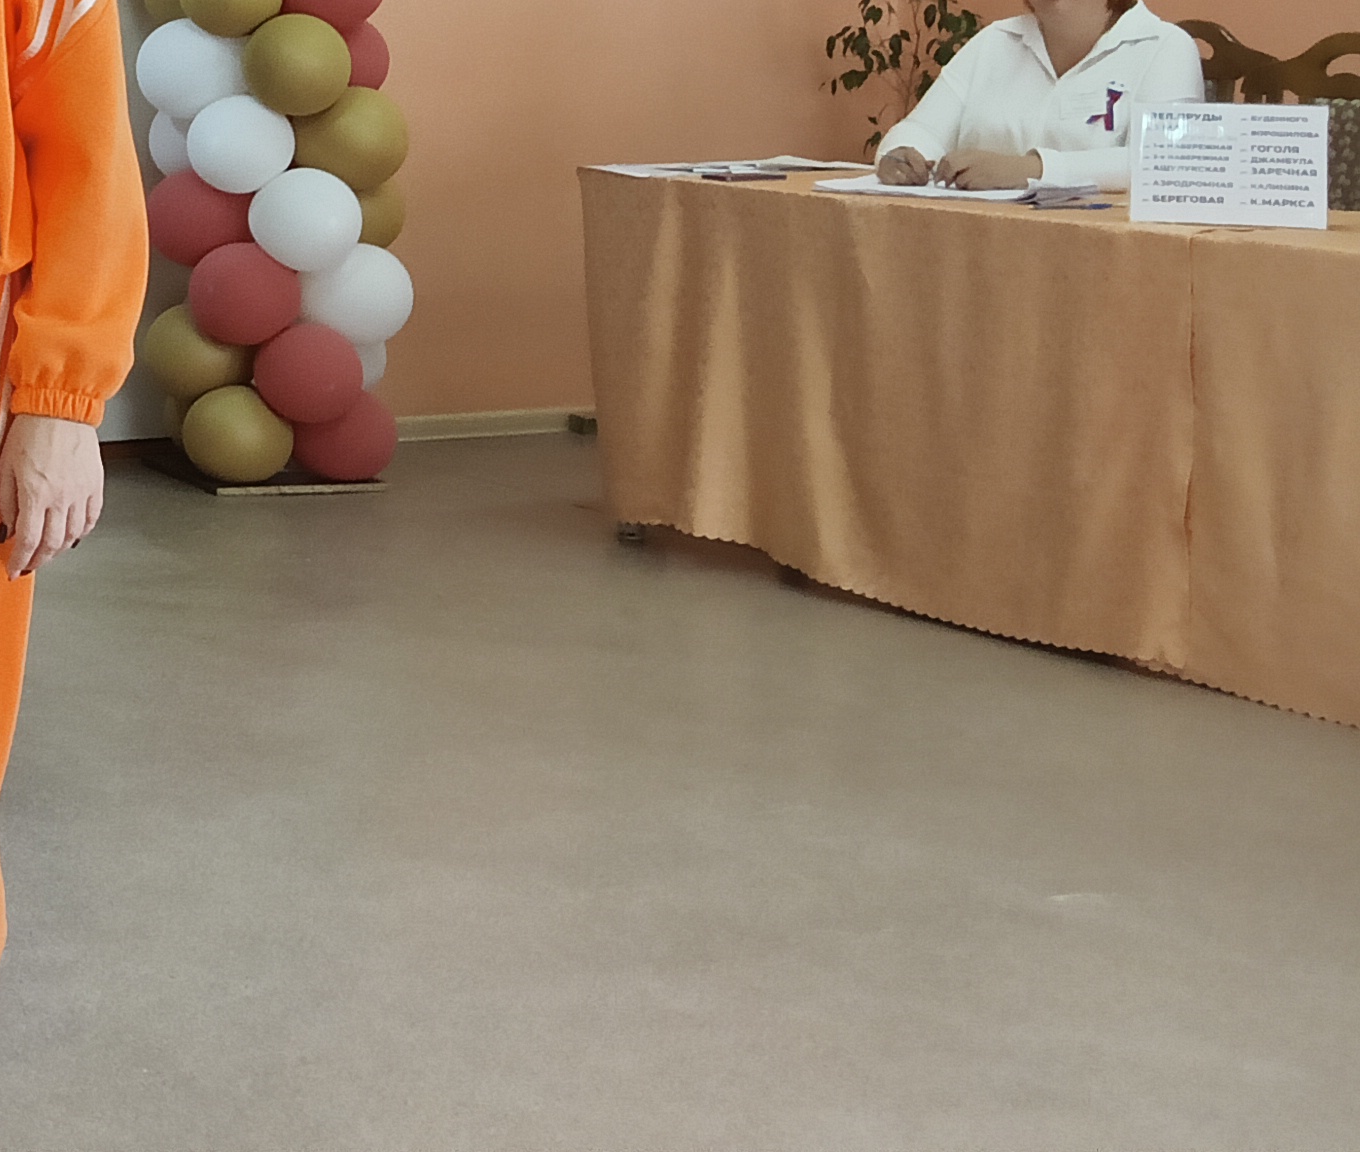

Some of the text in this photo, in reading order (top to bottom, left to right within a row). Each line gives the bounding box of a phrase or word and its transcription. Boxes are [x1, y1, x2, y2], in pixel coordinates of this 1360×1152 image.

[1250, 144, 1300, 154] ГОГОЛЯ
[1251, 167, 1318, 177] ЗАРЕЧНАЯ
[1152, 194, 1225, 204] БЕРЕГОВАЯ
